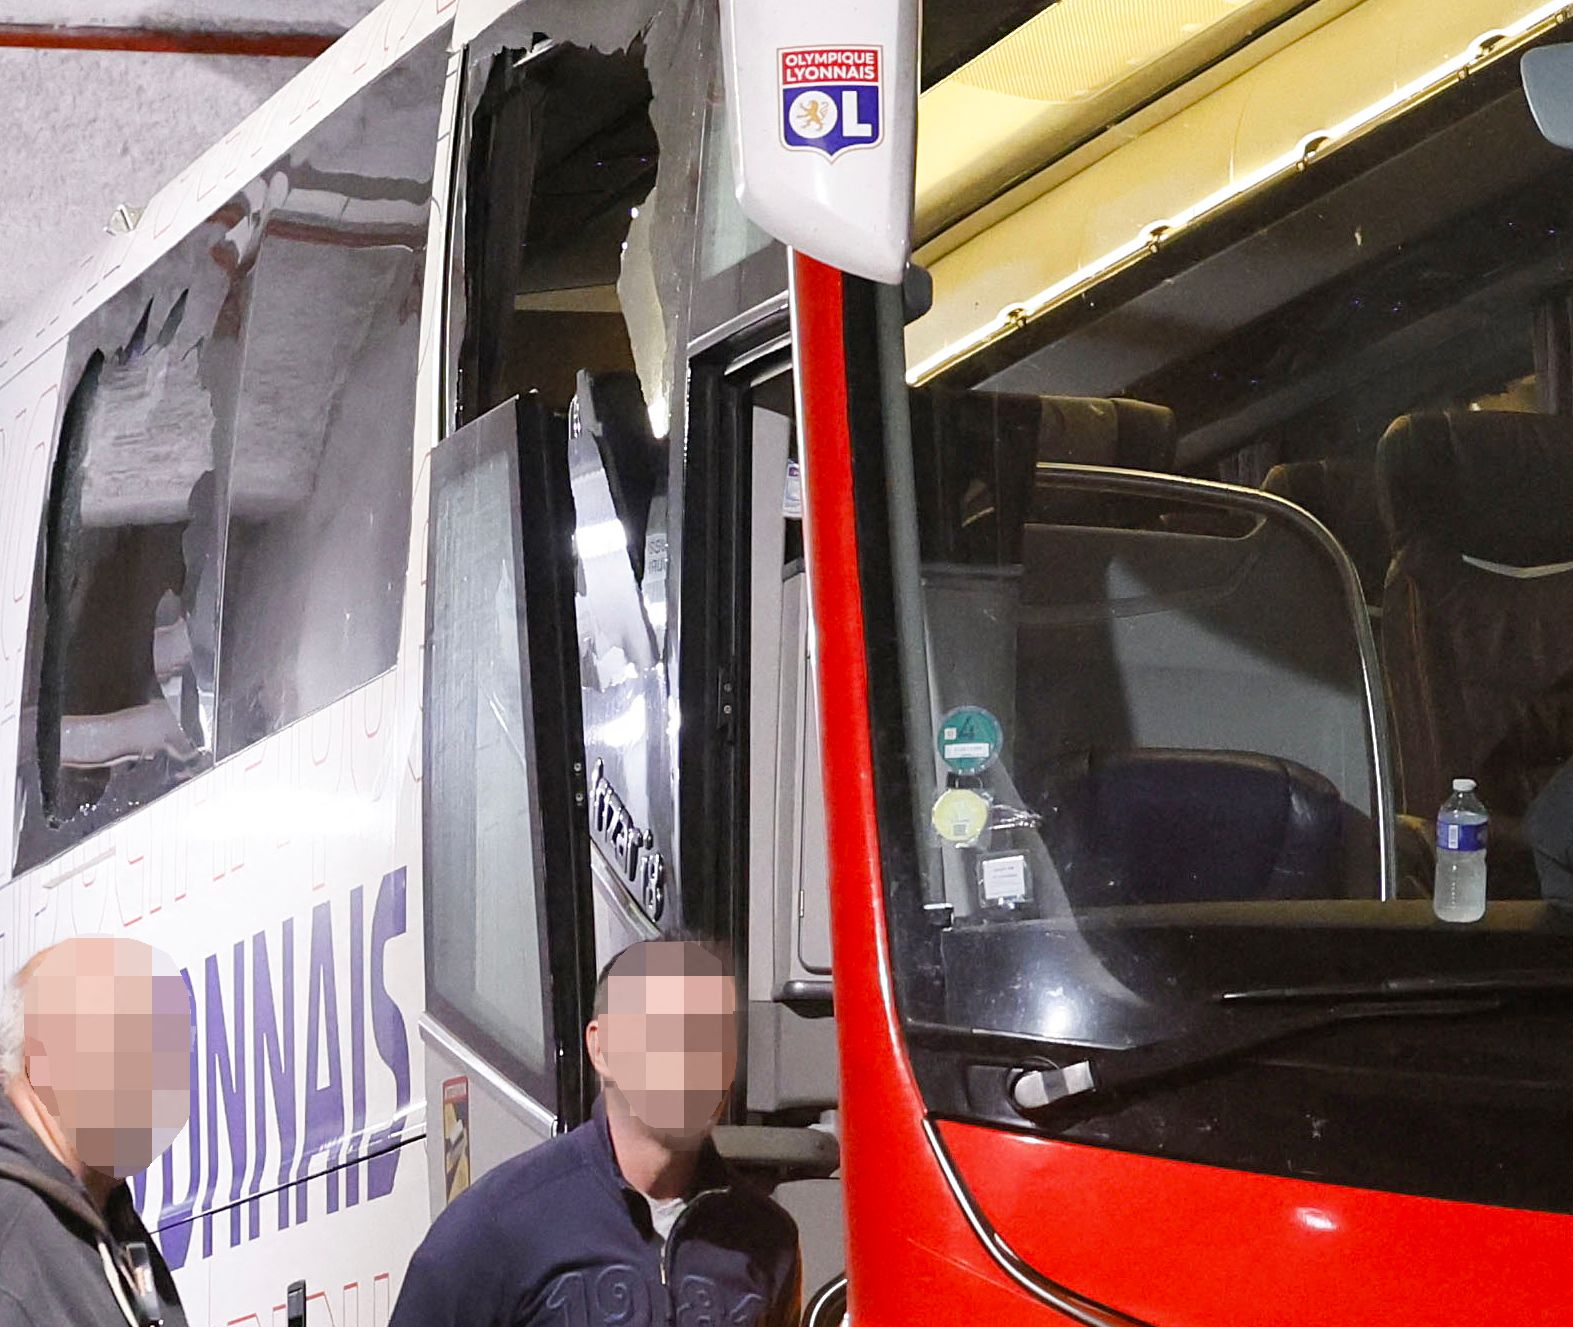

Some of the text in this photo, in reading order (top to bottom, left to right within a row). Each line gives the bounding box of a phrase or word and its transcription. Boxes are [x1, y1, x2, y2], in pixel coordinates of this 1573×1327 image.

[785, 51, 875, 68] OLYMPIQUE
[786, 65, 875, 82] LYONNAIS
[788, 90, 872, 139] OL
